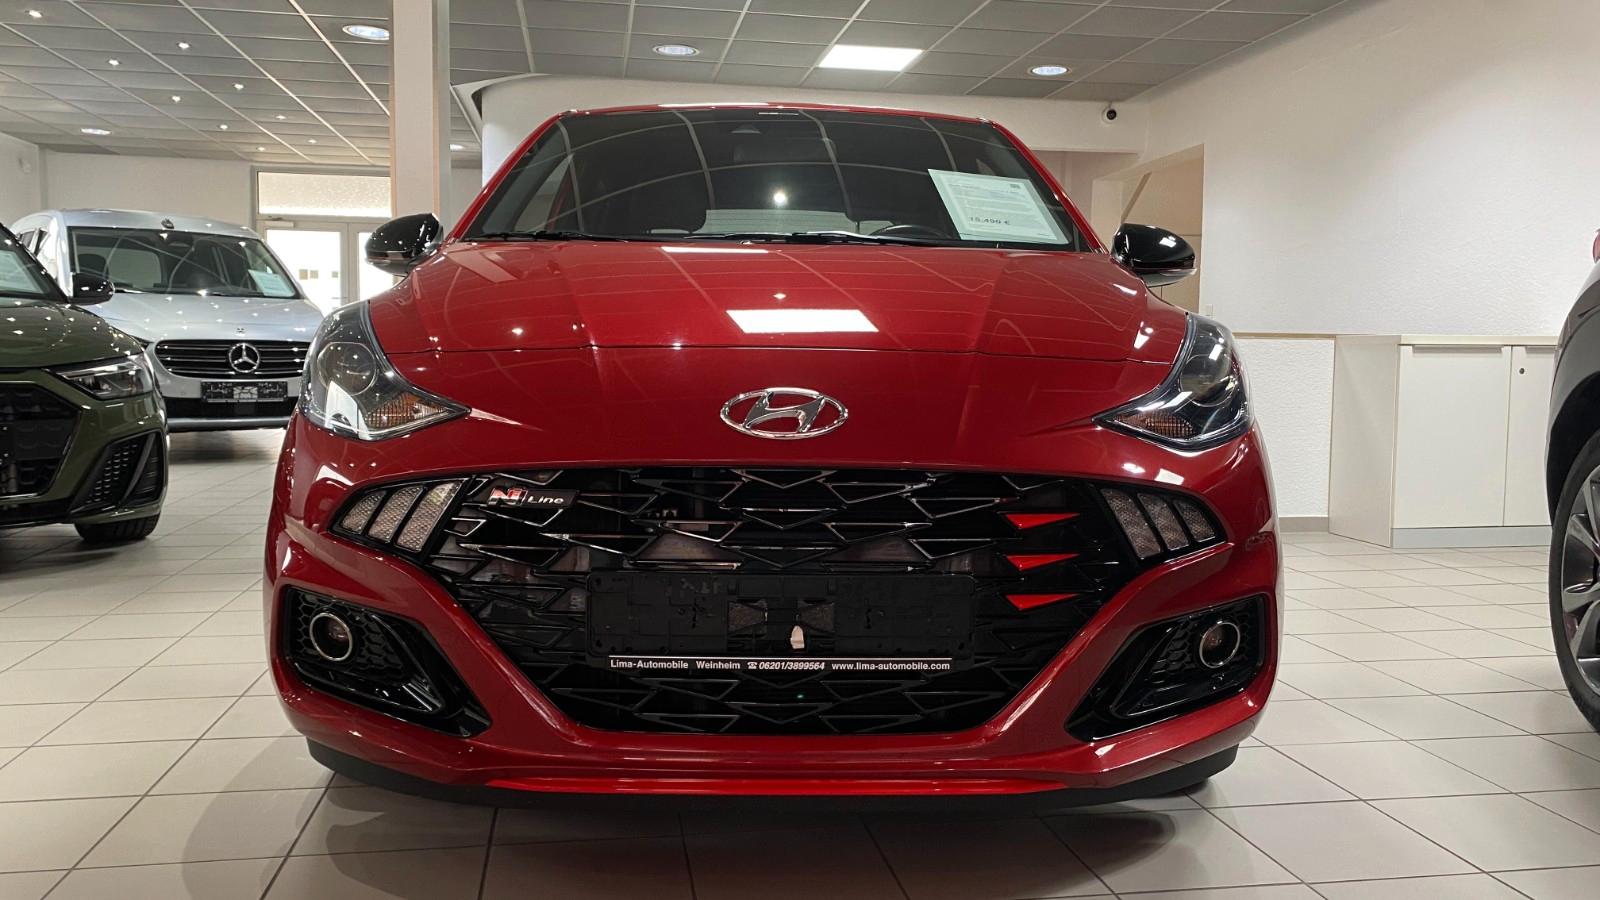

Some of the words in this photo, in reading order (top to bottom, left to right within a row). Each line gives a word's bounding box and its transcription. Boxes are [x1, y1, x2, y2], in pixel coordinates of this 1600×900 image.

[527, 495, 564, 505] Line
[610, 659, 689, 669] Lima-Automobile
[696, 660, 741, 670] Weinheim
[758, 661, 826, 671] 06201/3899564
[831, 661, 951, 671] www.lima-automobile.com
